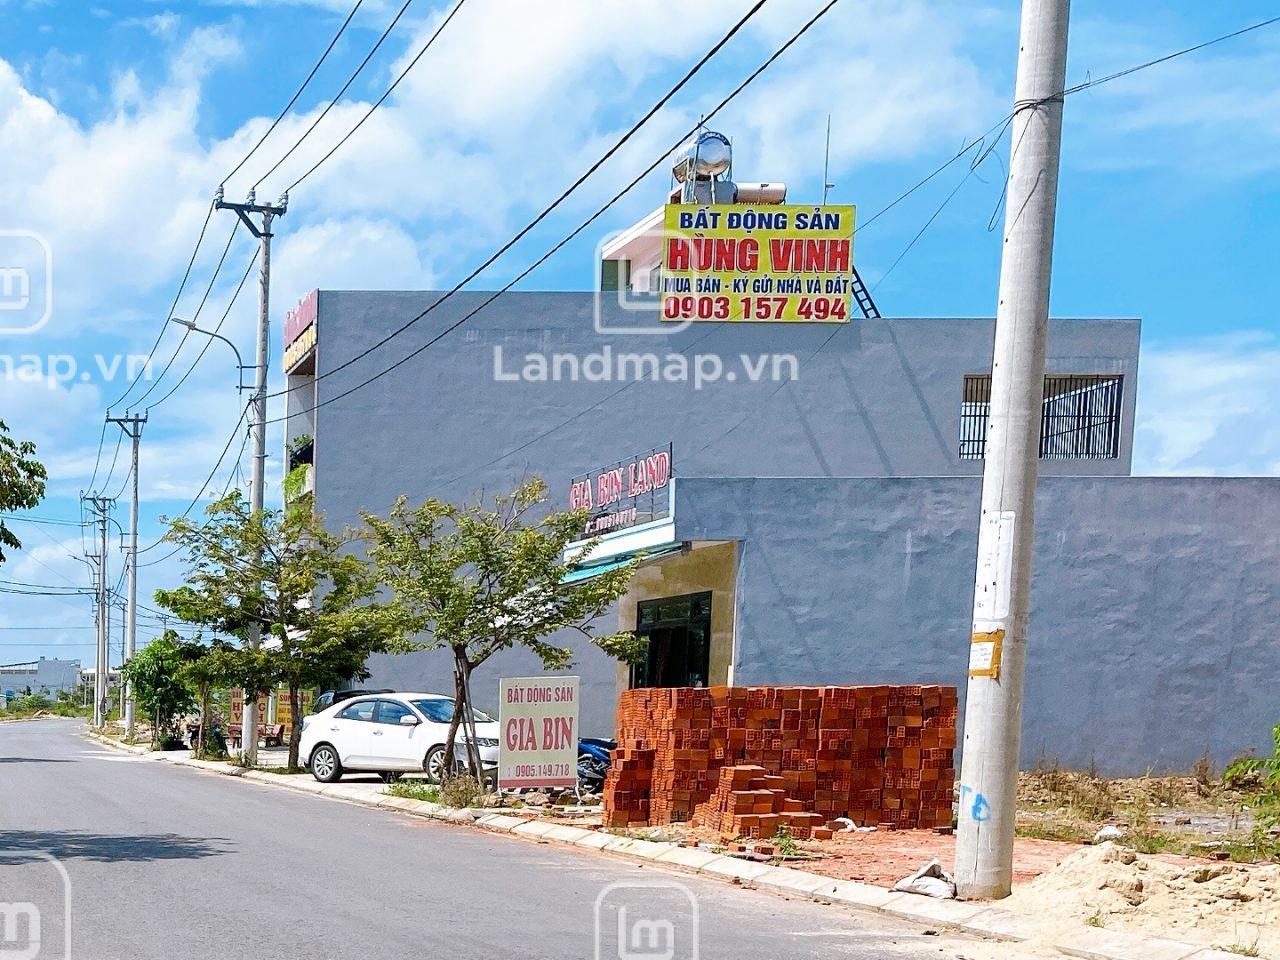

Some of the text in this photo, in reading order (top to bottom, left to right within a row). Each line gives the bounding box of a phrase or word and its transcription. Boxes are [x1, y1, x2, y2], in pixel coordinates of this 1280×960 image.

[680, 207, 840, 233] BẤT ĐỘNG SẢN
[668, 233, 851, 273] HÙNG VINH
[664, 278, 691, 293] MUA
[696, 277, 721, 293] BÁN
[733, 277, 750, 293] KÝ
[752, 275, 773, 294] GỬI
[776, 277, 803, 294] NHÀ
[806, 277, 822, 293] VÀ
[825, 274, 850, 293] ĐẤT
[664, 296, 847, 320] 0903 157 494
[570, 451, 669, 510] GIA BIN LAND
[506, 716, 574, 751] GIA BIN
